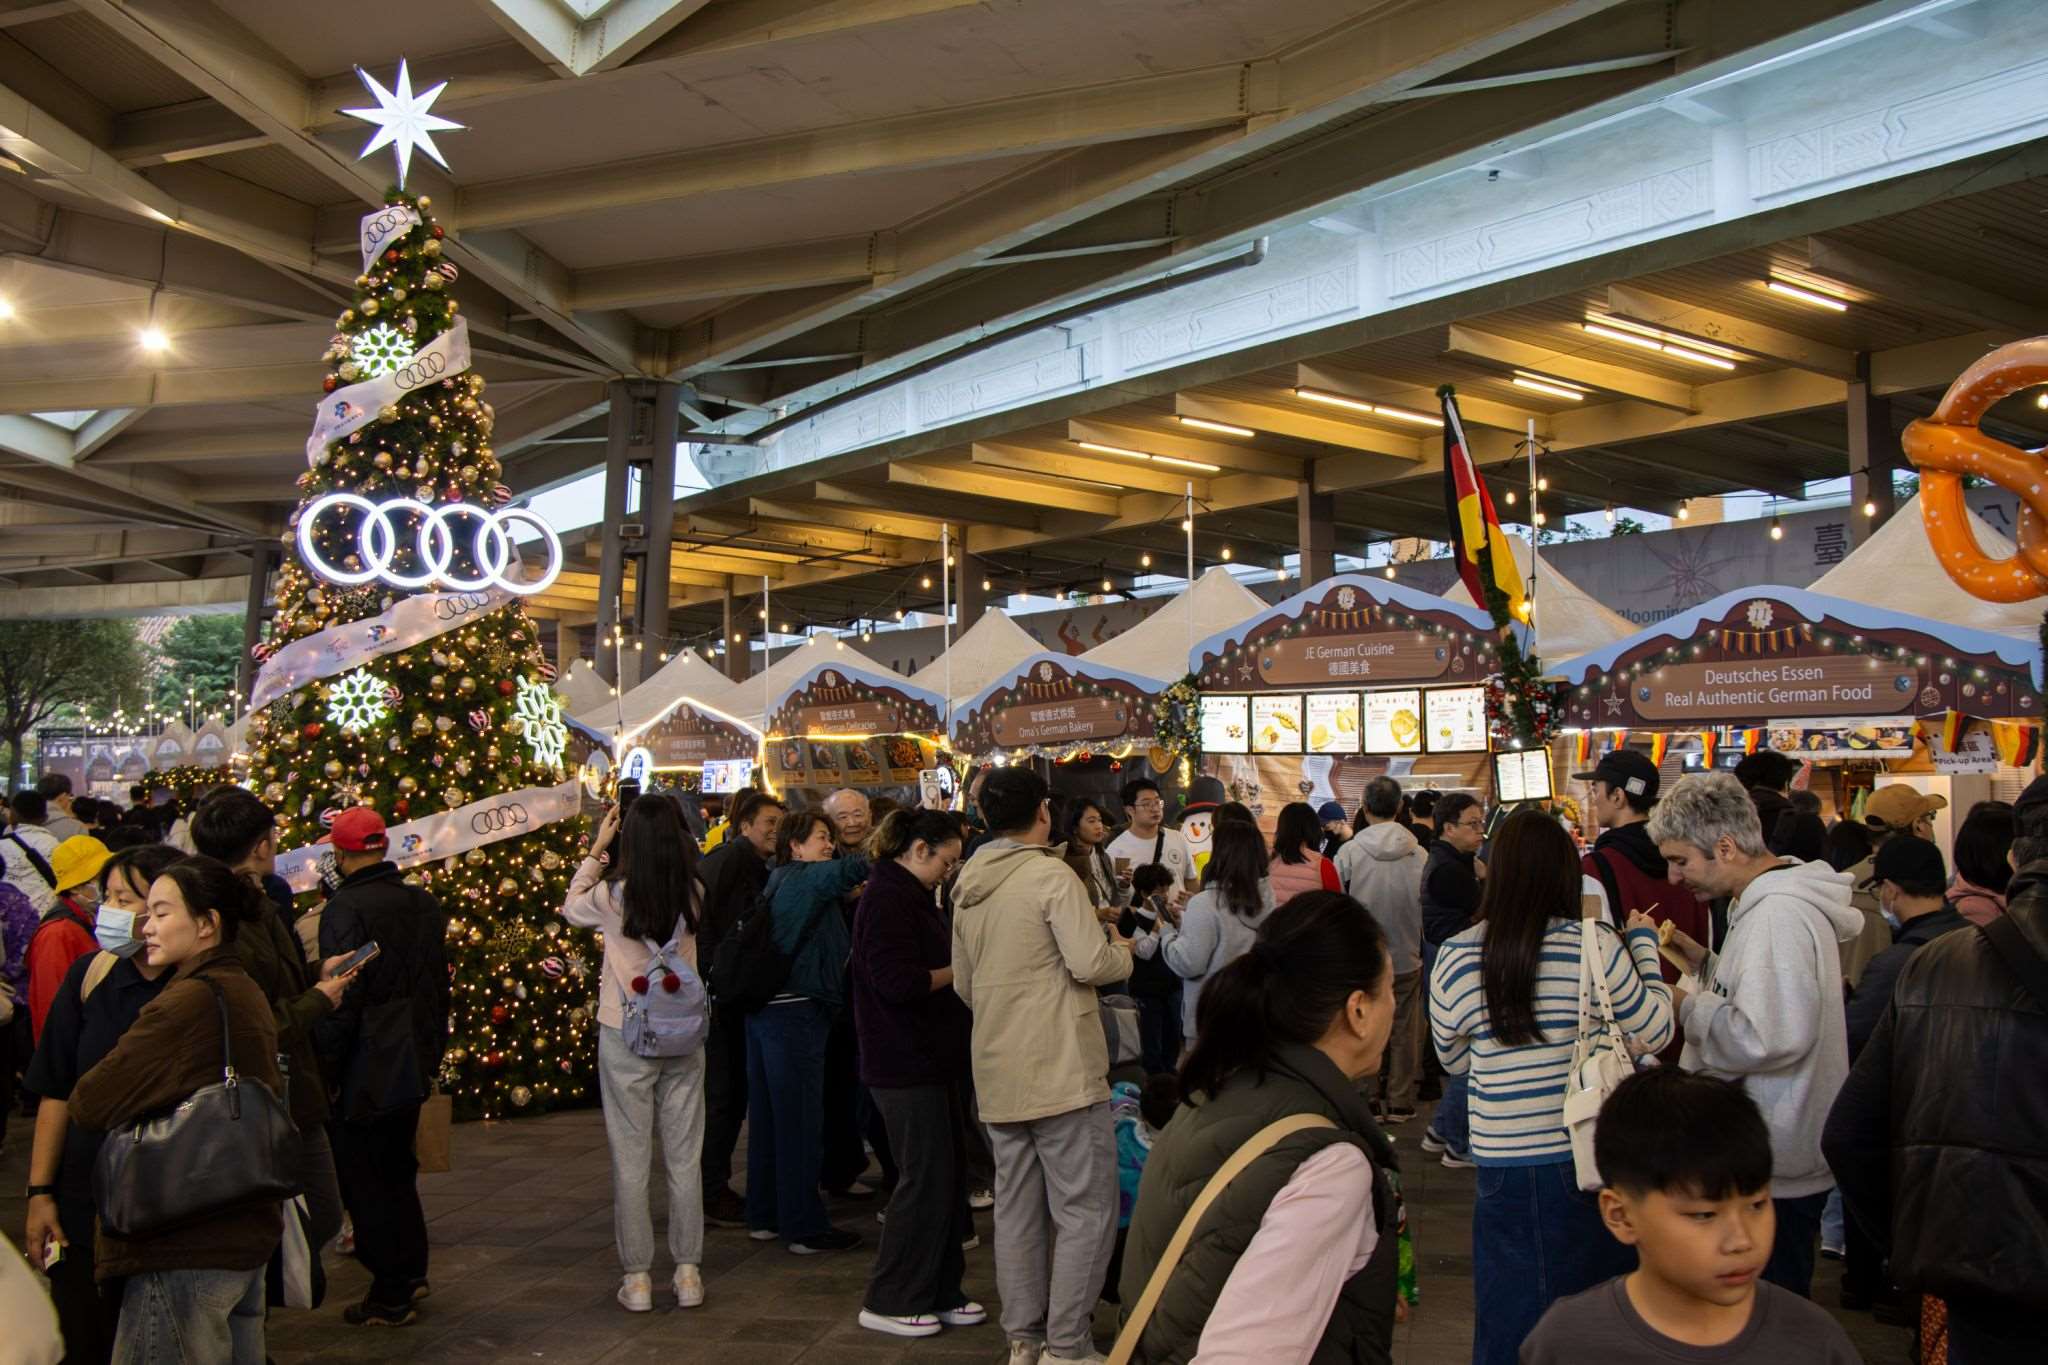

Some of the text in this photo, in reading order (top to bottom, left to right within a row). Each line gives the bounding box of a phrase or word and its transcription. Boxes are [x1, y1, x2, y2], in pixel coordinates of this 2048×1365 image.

[1317, 645, 1355, 658] German
[1357, 643, 1395, 656] Cuisine
[1705, 665, 1824, 685] Deutsches Essen
[1665, 683, 1872, 707] Real Authentic German Food
[1019, 721, 1094, 738] Oma's German Bakery
